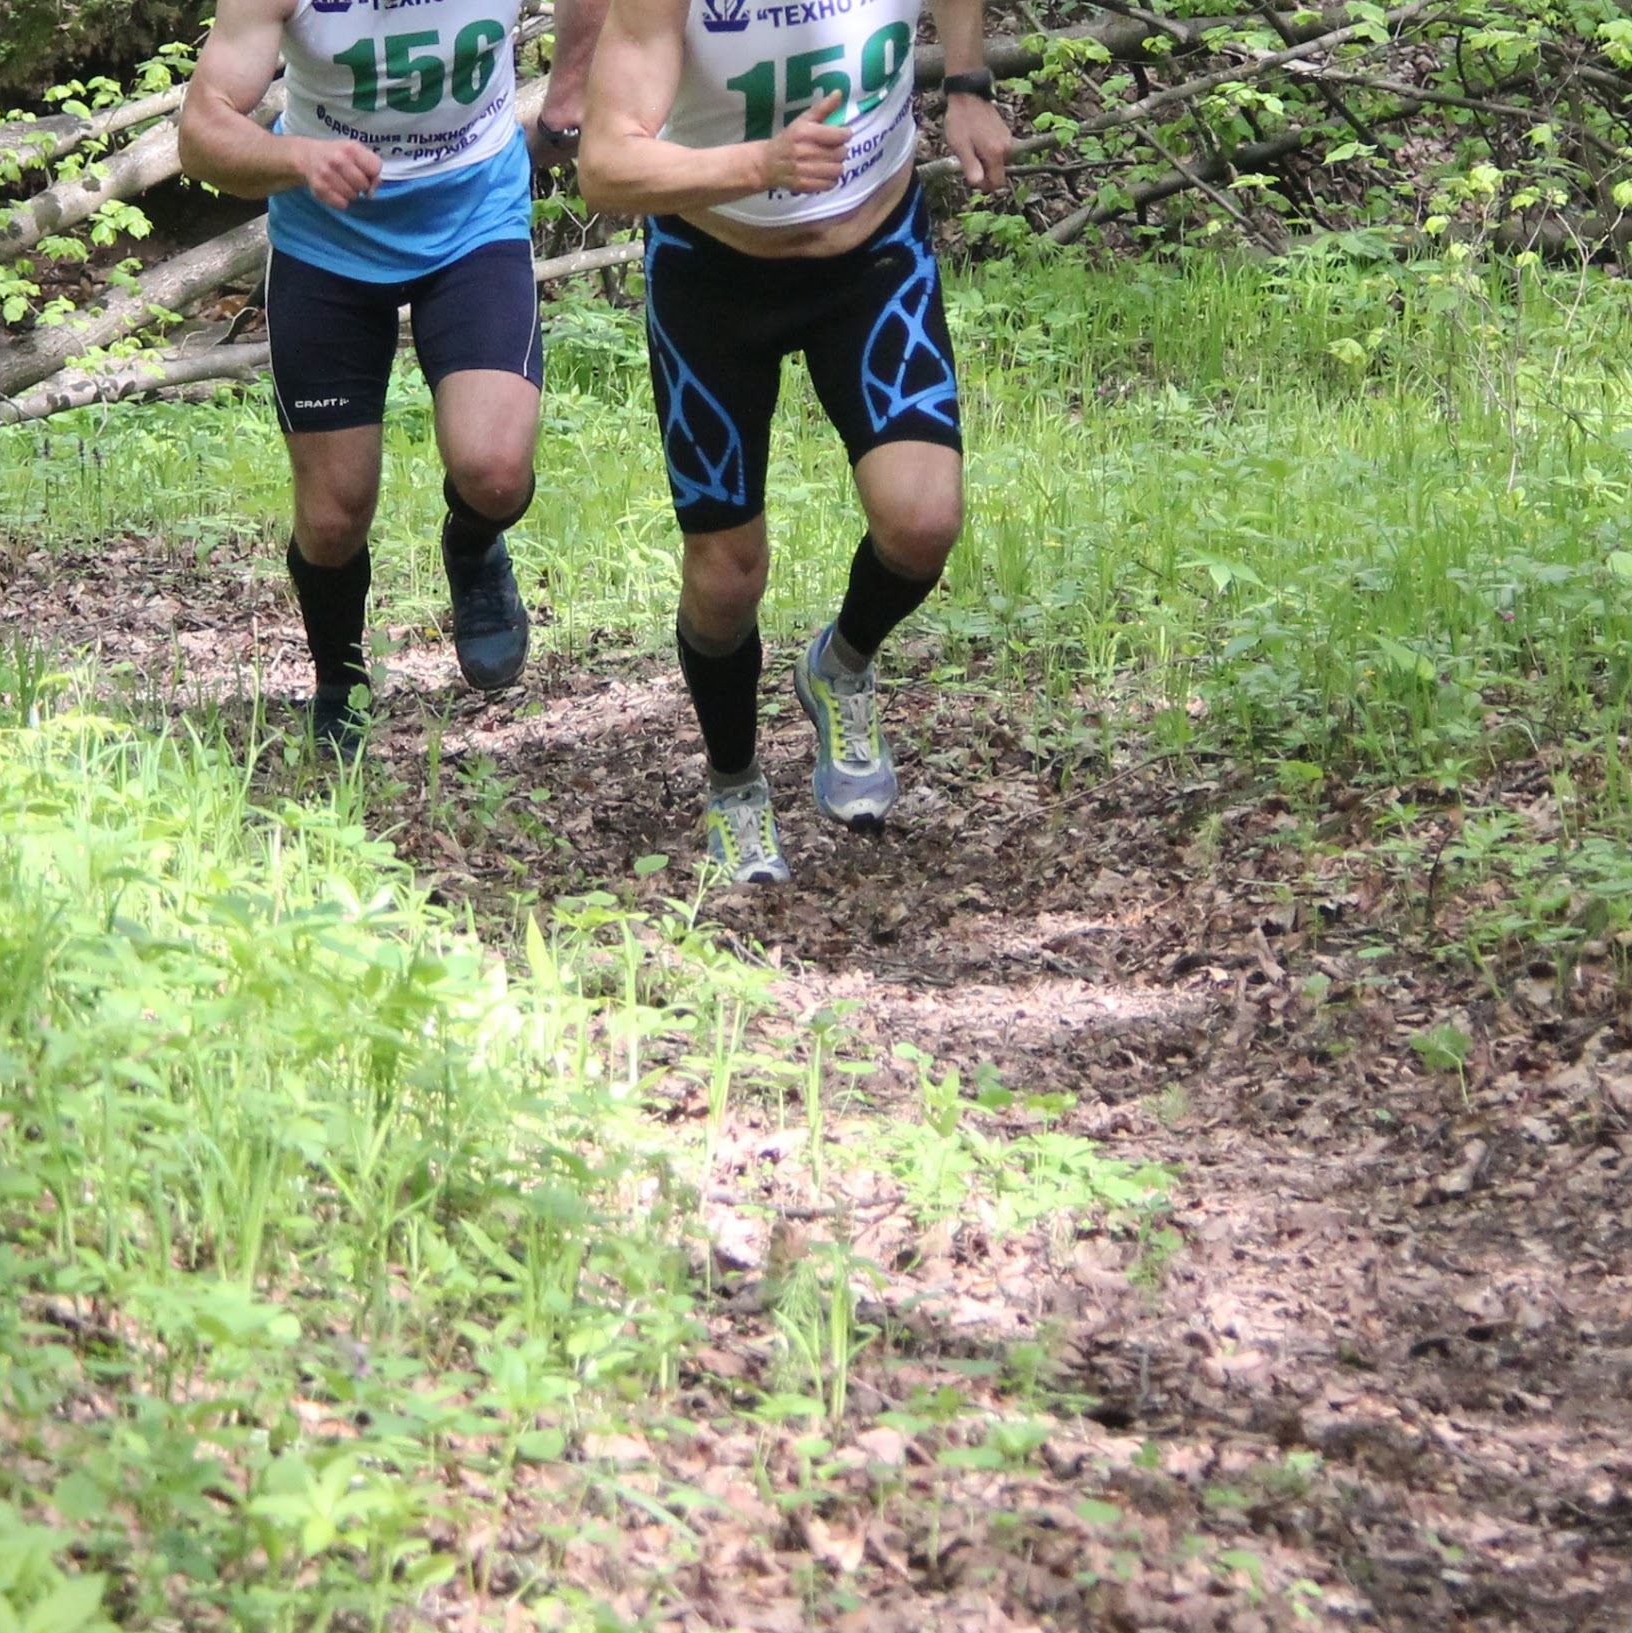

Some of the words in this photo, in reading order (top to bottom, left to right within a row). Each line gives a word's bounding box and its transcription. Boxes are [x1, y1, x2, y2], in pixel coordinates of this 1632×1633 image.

[727, 21, 912, 142] 159
[317, 104, 402, 144] Федерация
[294, 398, 338, 408] CRAFT
